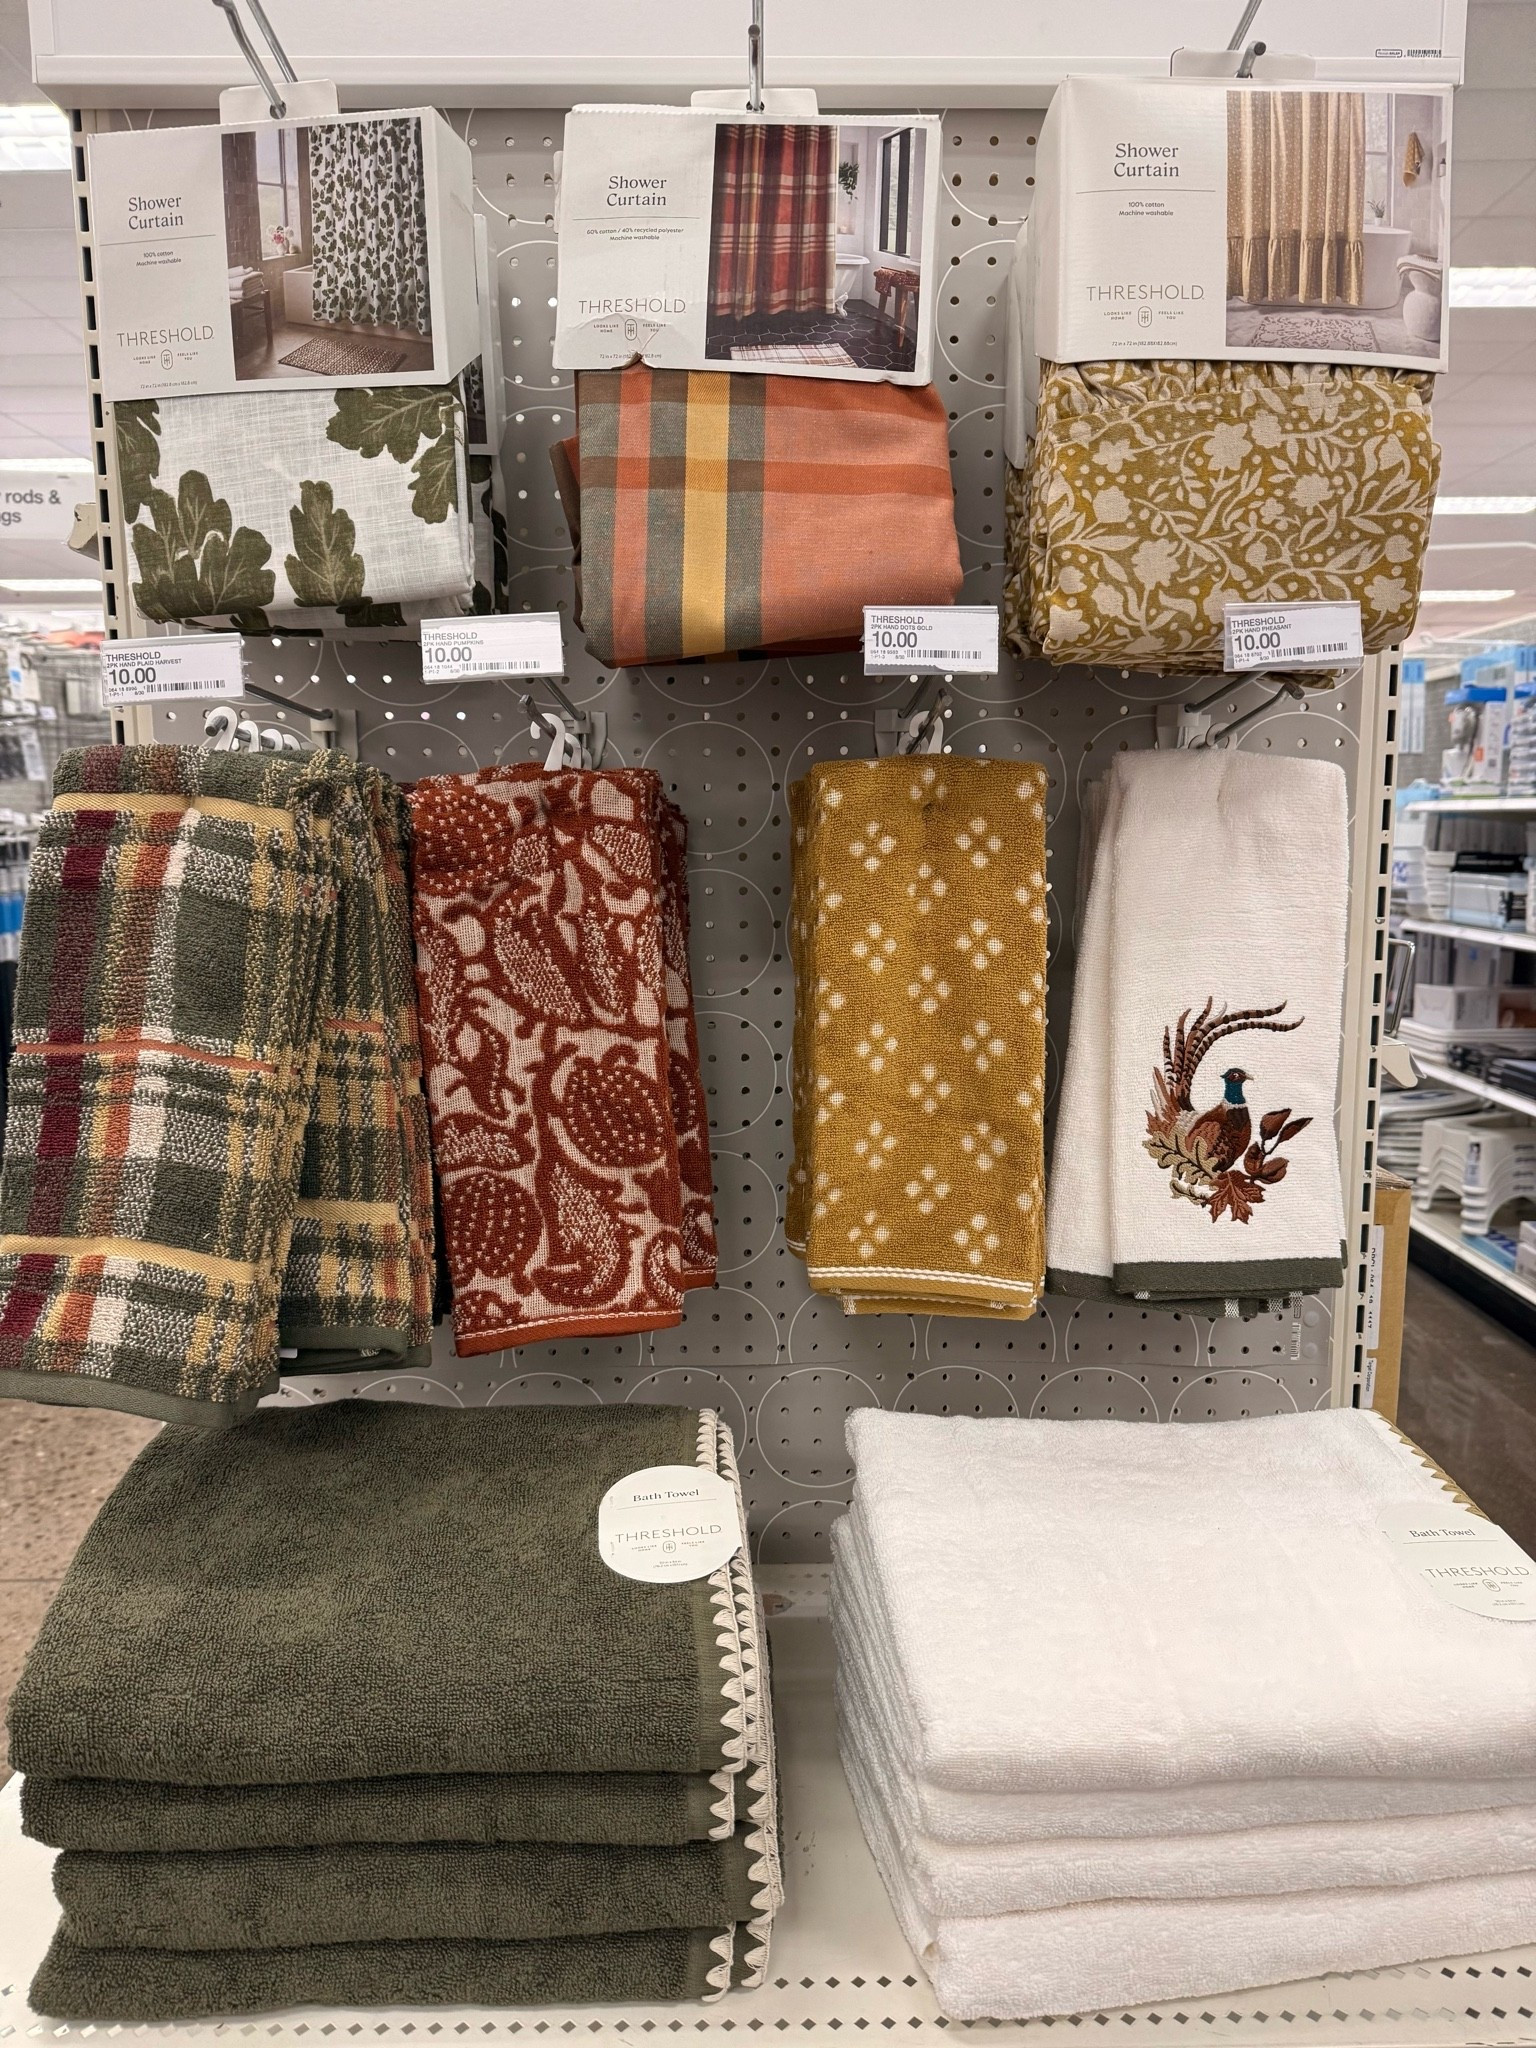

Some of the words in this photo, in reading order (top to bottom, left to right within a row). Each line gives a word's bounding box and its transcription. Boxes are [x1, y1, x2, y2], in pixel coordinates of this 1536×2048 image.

[1115, 142, 1179, 158] Shower
[1113, 162, 1180, 177] Curtain
[608, 175, 667, 189] Shower
[128, 196, 182, 212] Shower
[606, 192, 667, 206] Curtain
[128, 212, 184, 230] Curtain
[158, 257, 182, 265] washable
[1086, 284, 1204, 301] THRESHOLD
[578, 298, 686, 314] THRESHOLD
[116, 325, 214, 347] THRESHOLD
[5, 489, 44, 504] rods
[49, 489, 61, 504] &
[0, 511, 22, 526] gs
[870, 615, 924, 625] THRESHOLD
[1232, 615, 1285, 628] THRESHOLD
[1261, 623, 1292, 632] PHEASANT
[422, 632, 478, 641] THRESHOLD
[872, 630, 918, 648] 10.00
[1234, 631, 1281, 652] 10.00
[105, 651, 161, 663] THRESHOLD
[425, 646, 472, 663] 10.00
[108, 667, 157, 685] 10.00
[633, 1492, 662, 1502] Bath
[664, 1489, 699, 1499] Towel
[615, 1524, 722, 1543] THRESHOLD
[1409, 1529, 1440, 1538] Bath
[1438, 1528, 1476, 1537] Towel
[1425, 1566, 1531, 1578] THRESHOLD
